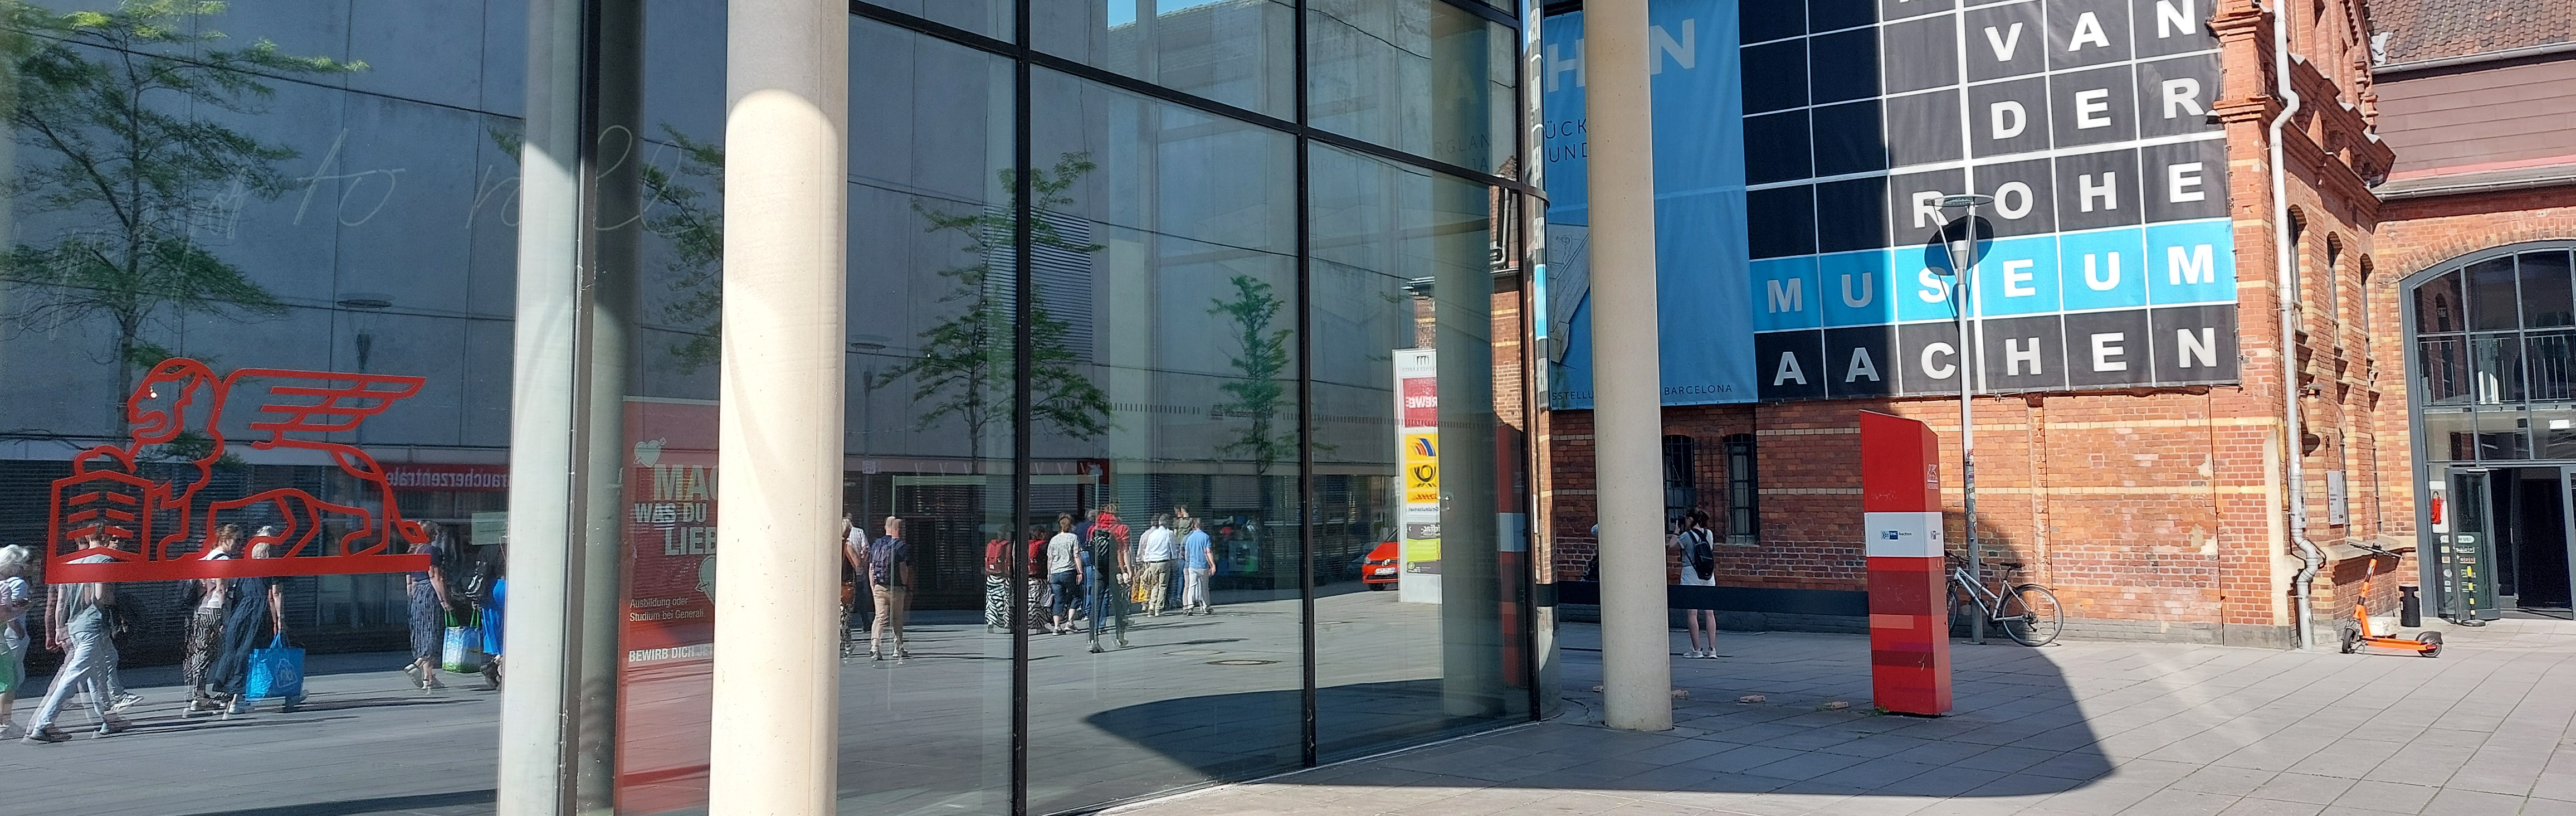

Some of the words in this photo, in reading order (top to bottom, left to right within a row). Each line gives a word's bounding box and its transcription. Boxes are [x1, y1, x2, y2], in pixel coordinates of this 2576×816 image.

[1984, 0, 2197, 62] VAN
[1990, 77, 2205, 140] DER
[1912, 162, 2205, 228] ROHE
[1767, 244, 2215, 313] MUSEUM
[1773, 327, 2217, 386] AACHEN
[1664, 384, 1733, 396] BARCELONA
[634, 503, 676, 523] WAS
[682, 503, 707, 522] DU
[630, 598, 670, 608] Ausbildung
[672, 597, 689, 606] oder
[630, 611, 660, 621] Studium
[662, 610, 673, 620] bei
[629, 648, 669, 662] BEWIRB
